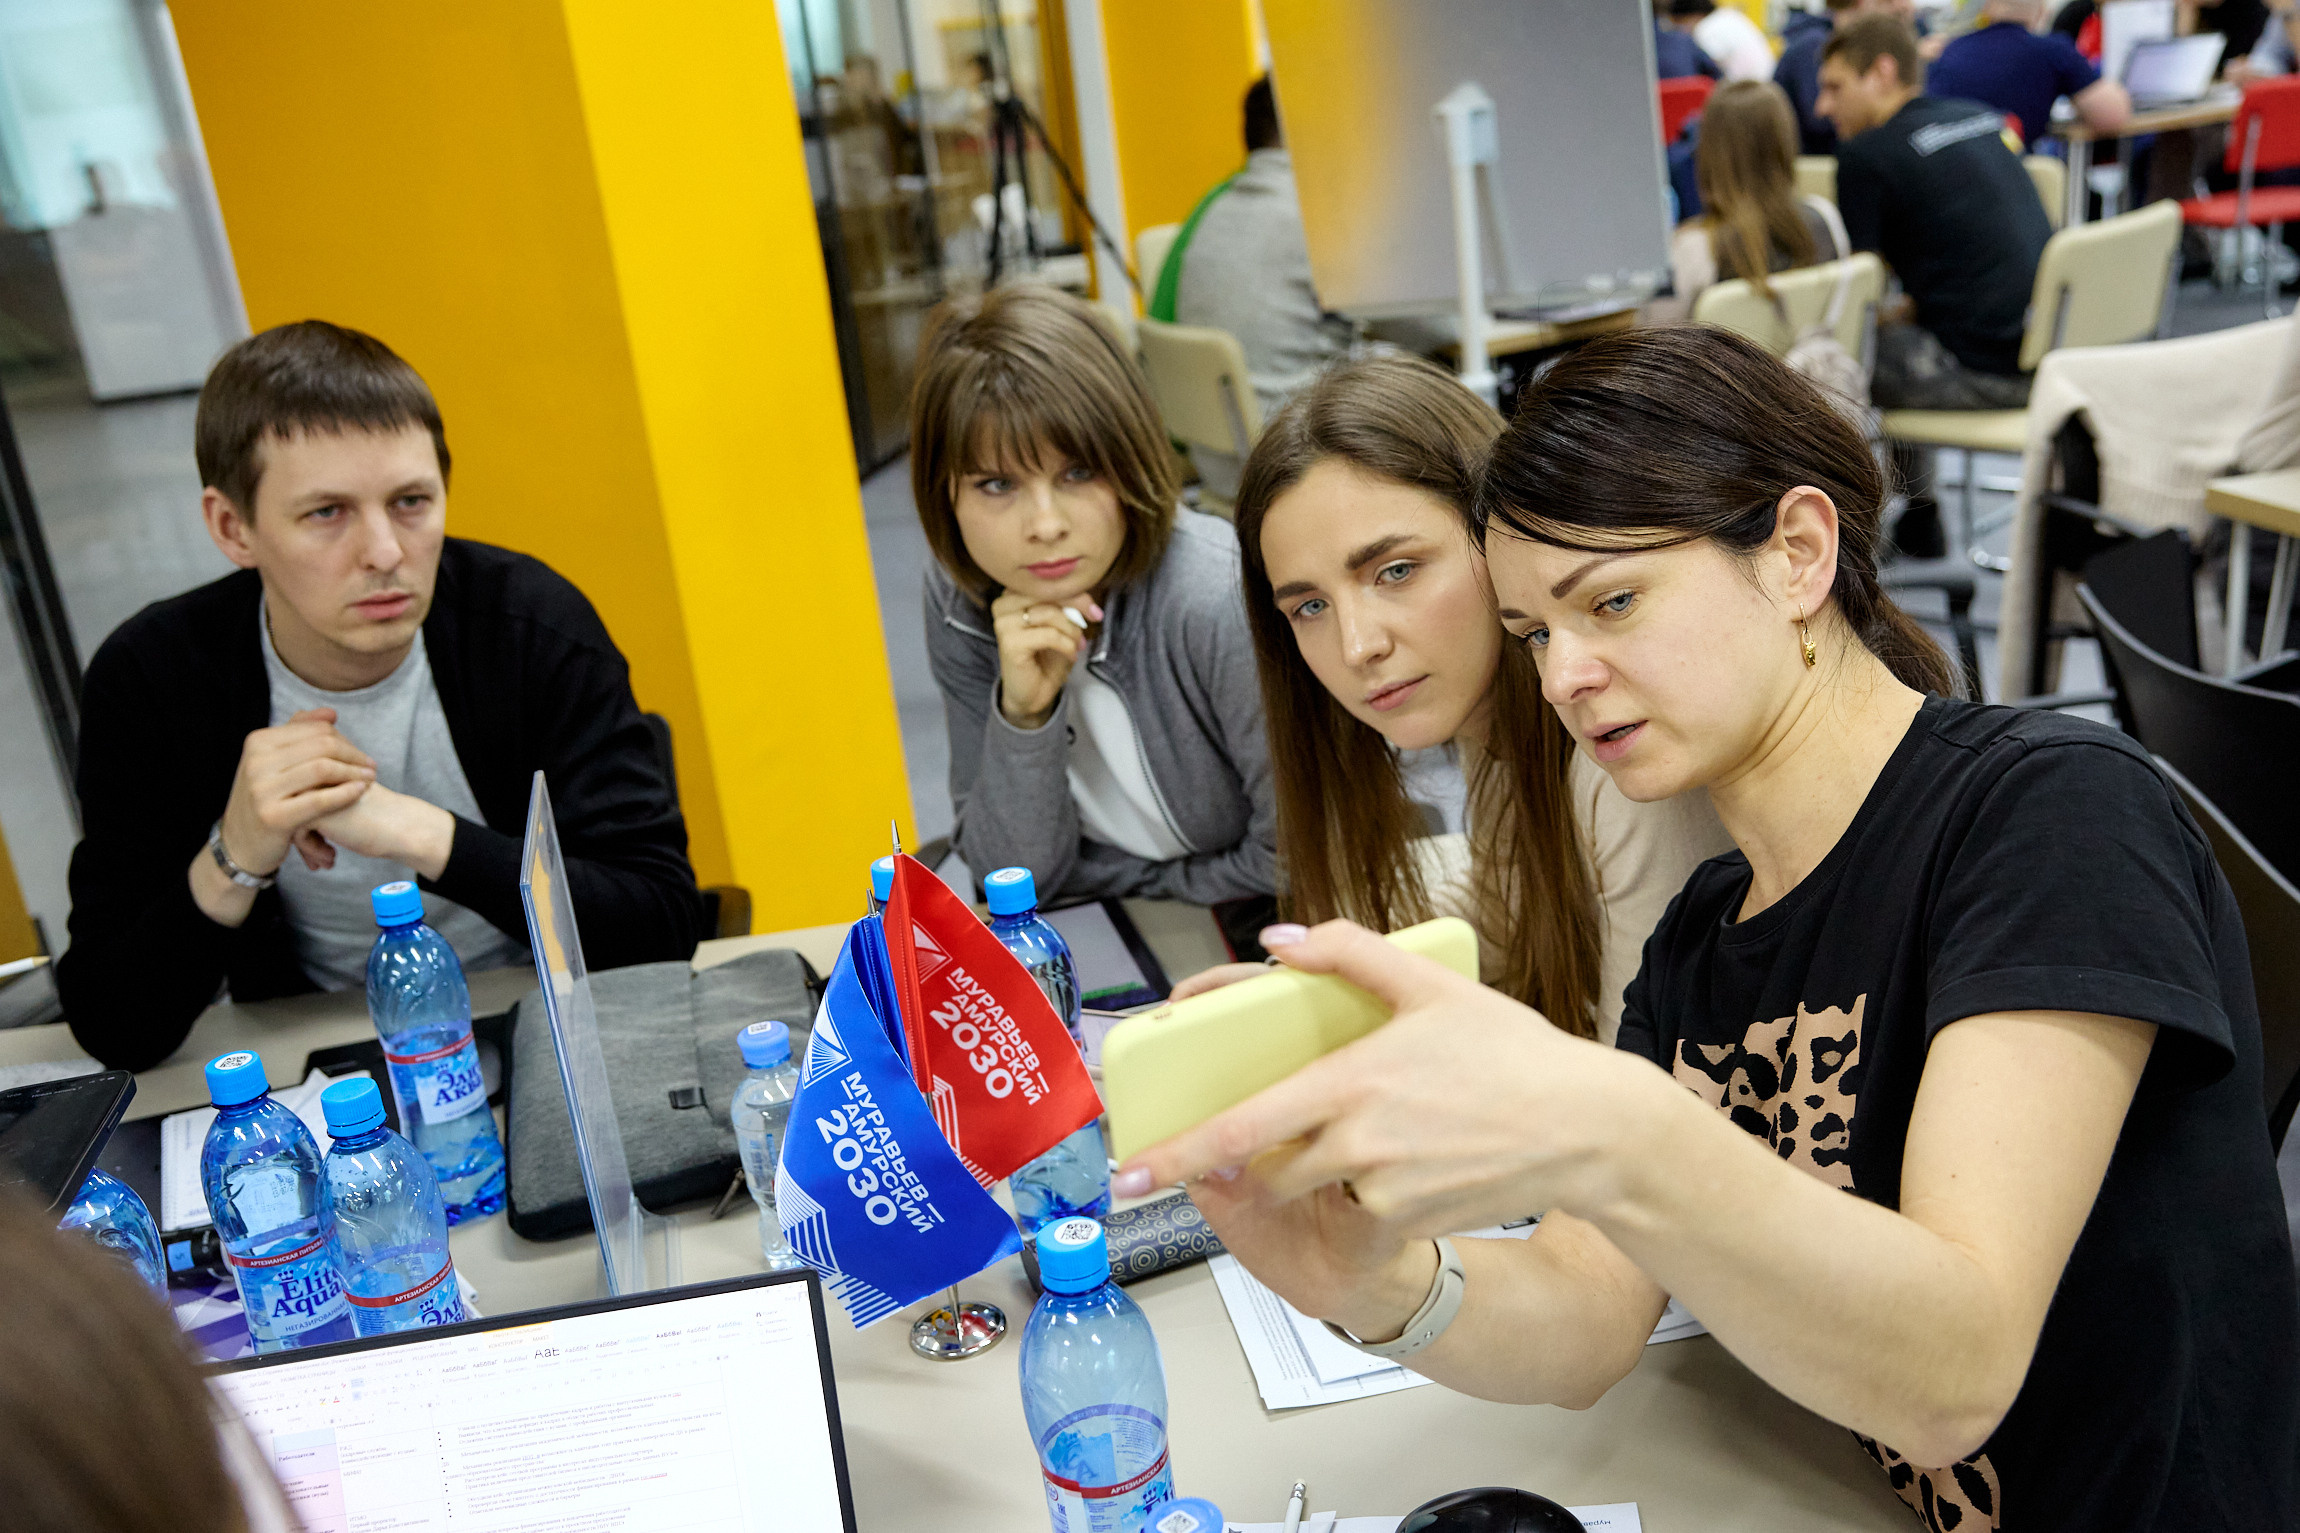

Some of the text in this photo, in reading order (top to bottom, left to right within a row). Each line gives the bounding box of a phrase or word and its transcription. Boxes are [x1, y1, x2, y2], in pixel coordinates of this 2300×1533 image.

[929, 1001, 1014, 1099] 2030
[950, 966, 1041, 1072] МУРАВЬЕВ
[951, 993, 1043, 1106] АМУРСКИЙ
[815, 1109, 898, 1226] 2030
[841, 1103, 936, 1234] АМУРСКИЙ
[846, 1071, 930, 1202] МУРАВЬЕВ
[250, 1253, 299, 1267] АРТЕЗИАНСКАЯ
[272, 1281, 341, 1318] Aqua
[394, 1276, 440, 1303] АРТЕЗИАНСКАЯ
[1110, 1463, 1160, 1495] АРТЕЗИАНСКАЯ
